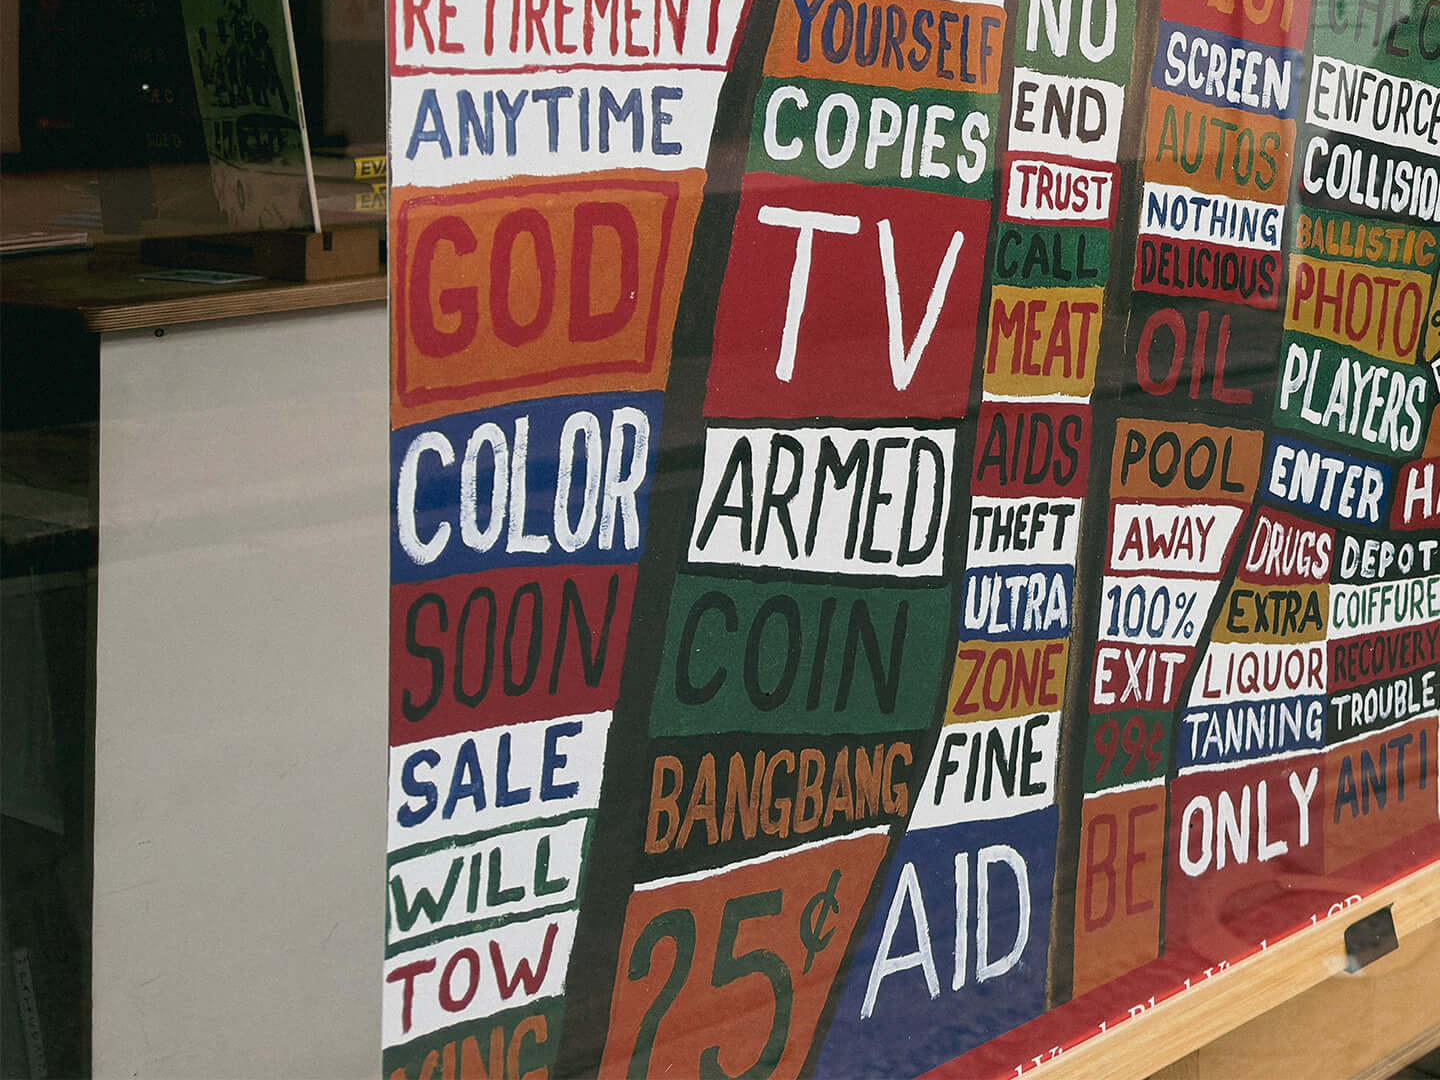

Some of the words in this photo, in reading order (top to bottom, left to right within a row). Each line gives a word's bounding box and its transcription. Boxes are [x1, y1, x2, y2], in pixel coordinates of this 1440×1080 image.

[1164, 31, 1291, 111] SCREEN
[405, 86, 684, 160] ANYTIME
[762, 85, 991, 184] COPIES
[1013, 80, 1107, 143] END
[1157, 104, 1281, 192] AUTOS
[1016, 165, 1108, 212] TRUST
[1147, 191, 1279, 247] NOTHING
[409, 201, 640, 358] GOD
[996, 229, 1098, 281] CALL
[1141, 239, 1277, 300] DELICIOUS
[1295, 213, 1437, 267] BALLISTIC
[757, 204, 965, 392] TV
[1292, 262, 1423, 357] PHOTO
[986, 298, 1099, 380] MEAT
[1136, 307, 1253, 405] OIL
[1280, 343, 1427, 453] PLAYERS
[397, 406, 650, 565] COLOR
[976, 412, 1082, 487] AIDS
[1121, 429, 1245, 493] POOL
[1268, 444, 1385, 523] ENTER
[696, 433, 946, 567] ARMED
[972, 502, 1075, 552] THEFT
[1118, 515, 1216, 564] AWAY
[1245, 516, 1332, 580] DRUGS
[1339, 535, 1438, 580] DEPOT
[964, 571, 1068, 634] ULTRA
[1106, 583, 1198, 640] 100%
[1227, 589, 1323, 636] EXTRA
[402, 573, 619, 722] SOON
[675, 591, 910, 715] COIN
[952, 643, 1064, 717] ZONE
[1093, 647, 1186, 706] EXIT
[1202, 647, 1325, 699] LIQUOR
[1334, 624, 1440, 684] RECOVERY
[1184, 699, 1323, 760] TANNING
[1330, 670, 1436, 732] TROUBLE
[397, 720, 583, 828] SALE
[644, 741, 913, 854] BANGBANG
[933, 713, 1050, 807] FINE
[1333, 728, 1427, 825] ANTI
[1179, 767, 1319, 877] ONLY
[389, 834, 570, 932] WILL
[1083, 804, 1160, 932] BE
[860, 843, 1031, 1021] AID
[386, 922, 559, 1034] TOW
[628, 869, 842, 1080] 25¢
